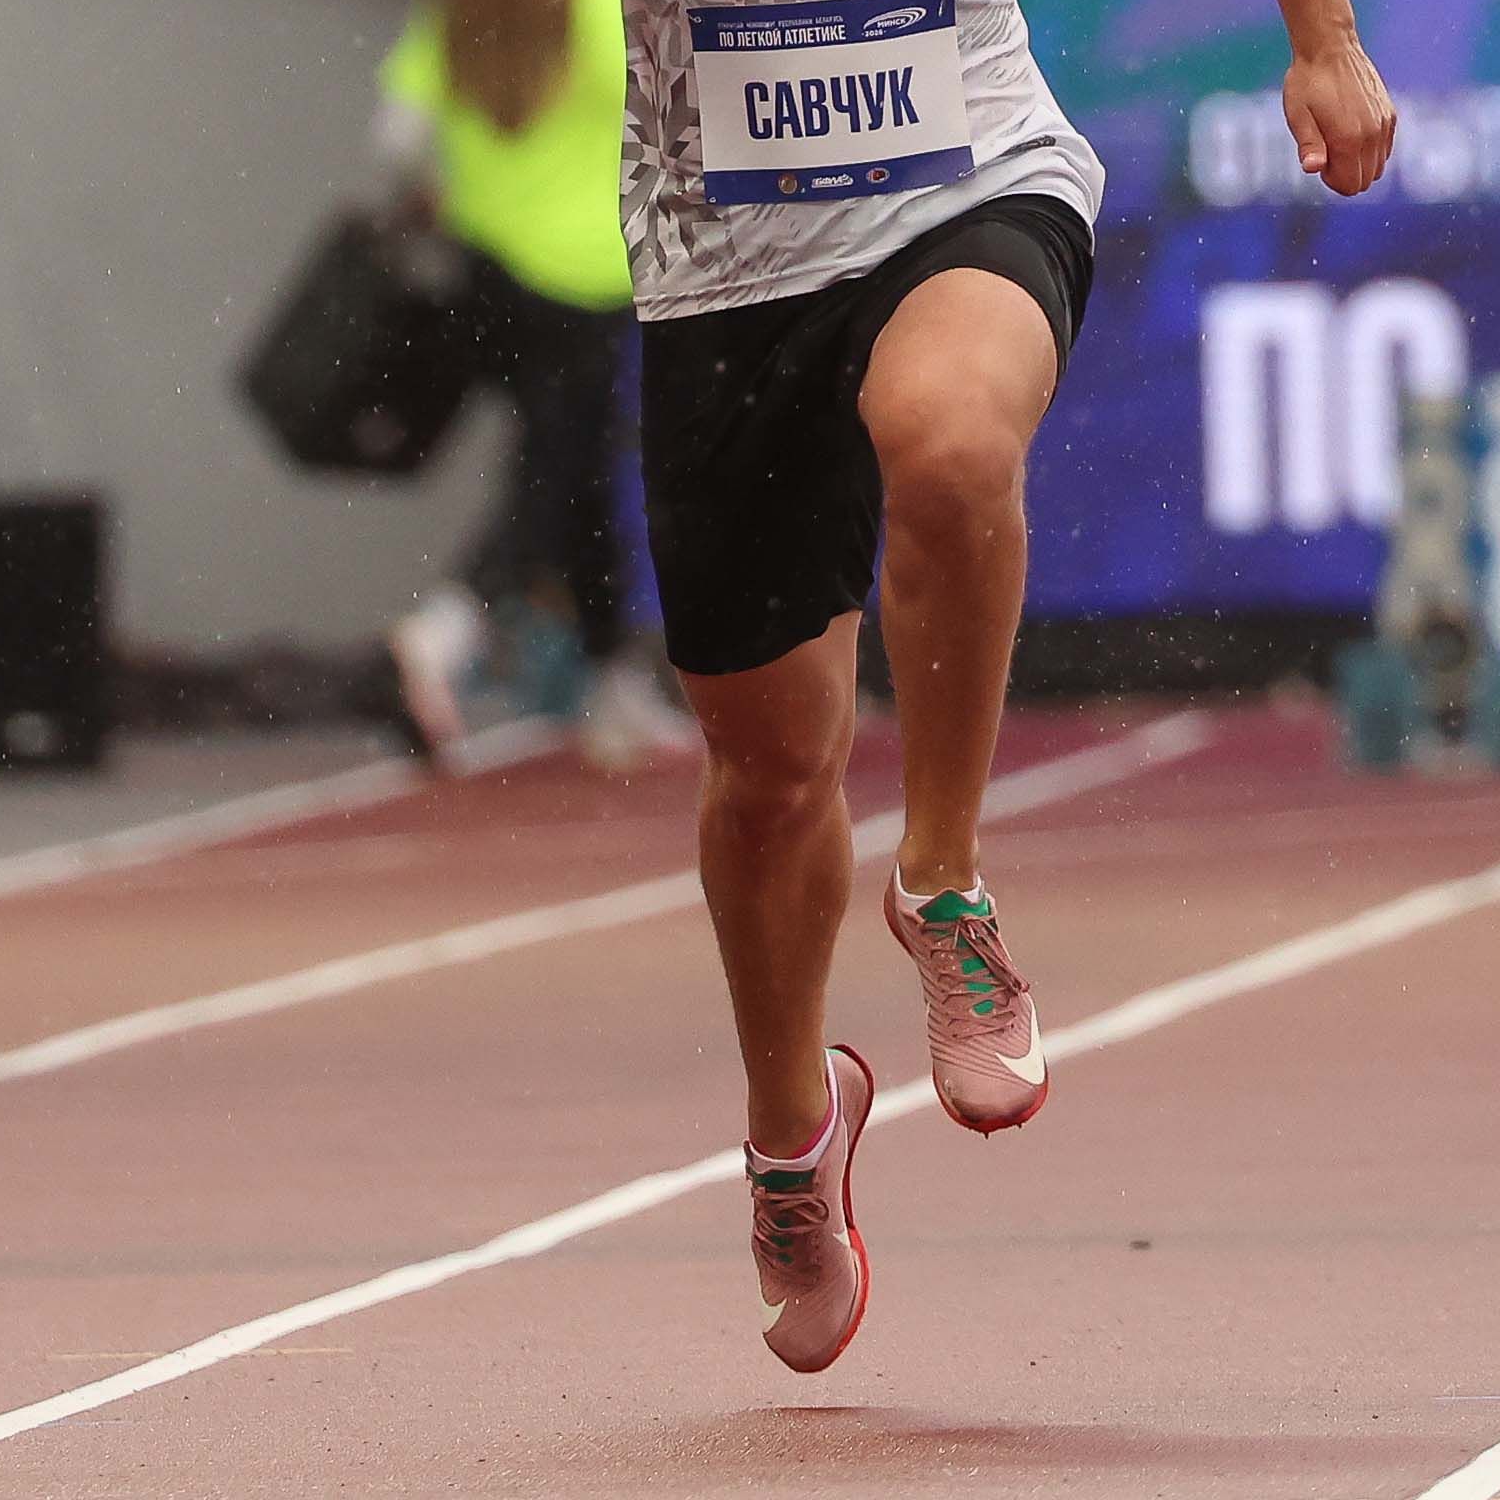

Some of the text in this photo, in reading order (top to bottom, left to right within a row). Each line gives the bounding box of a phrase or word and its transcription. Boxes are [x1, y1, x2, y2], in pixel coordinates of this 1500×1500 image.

[876, 17, 907, 29] МИНСК
[718, 24, 846, 47] ПО ЛЕГКОЙ АТЛЕТИКЕ
[744, 66, 920, 140] САВЧУК
